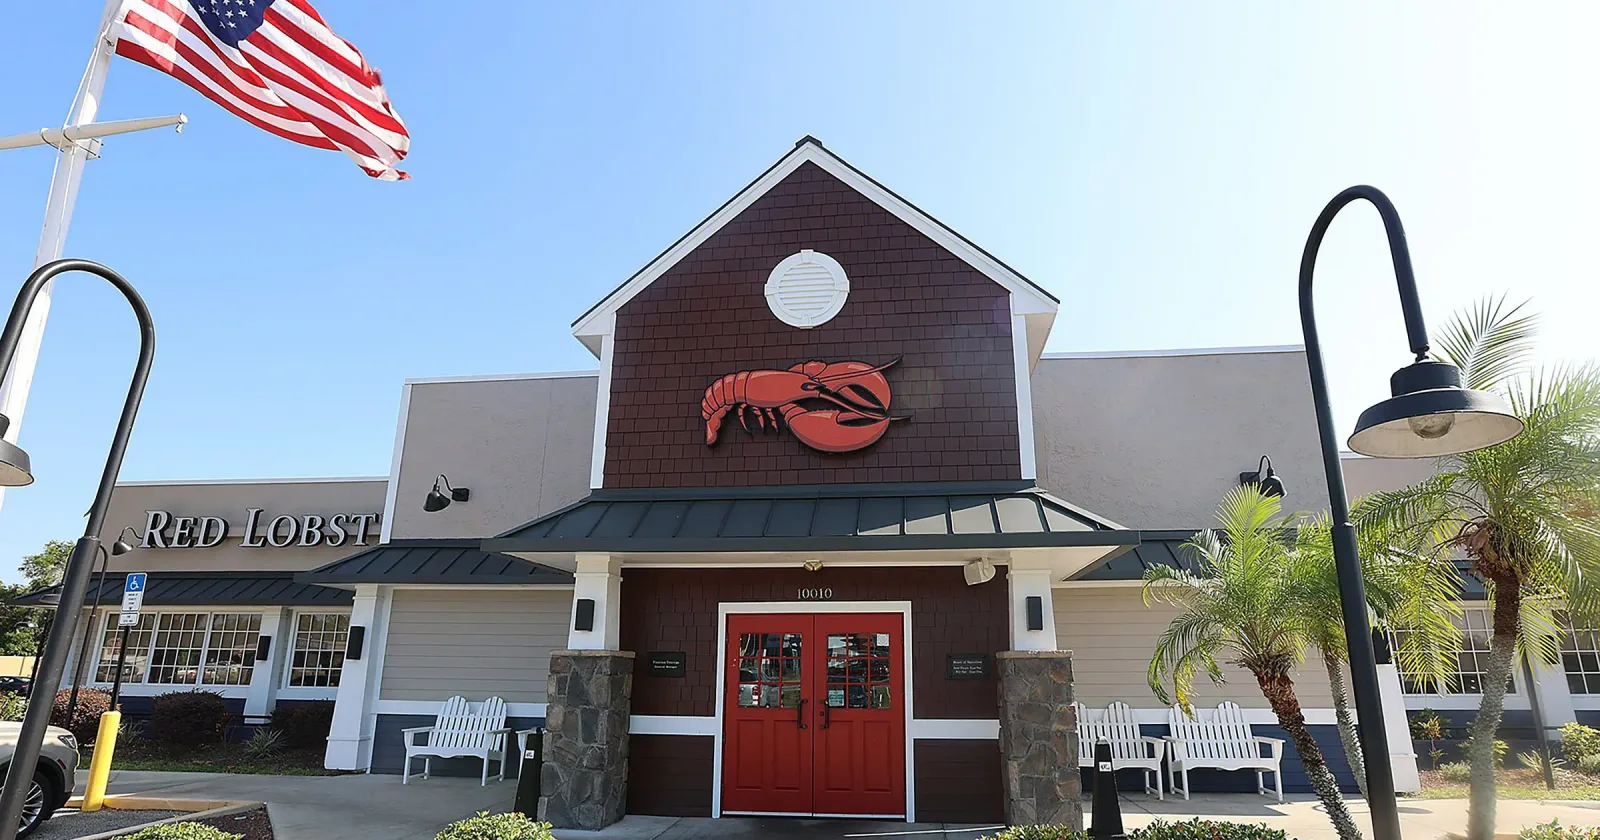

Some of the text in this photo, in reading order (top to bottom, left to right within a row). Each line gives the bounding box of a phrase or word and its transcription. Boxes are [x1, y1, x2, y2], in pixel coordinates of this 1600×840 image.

[138, 508, 384, 548] RED LOBST
[797, 588, 833, 600] 10010
